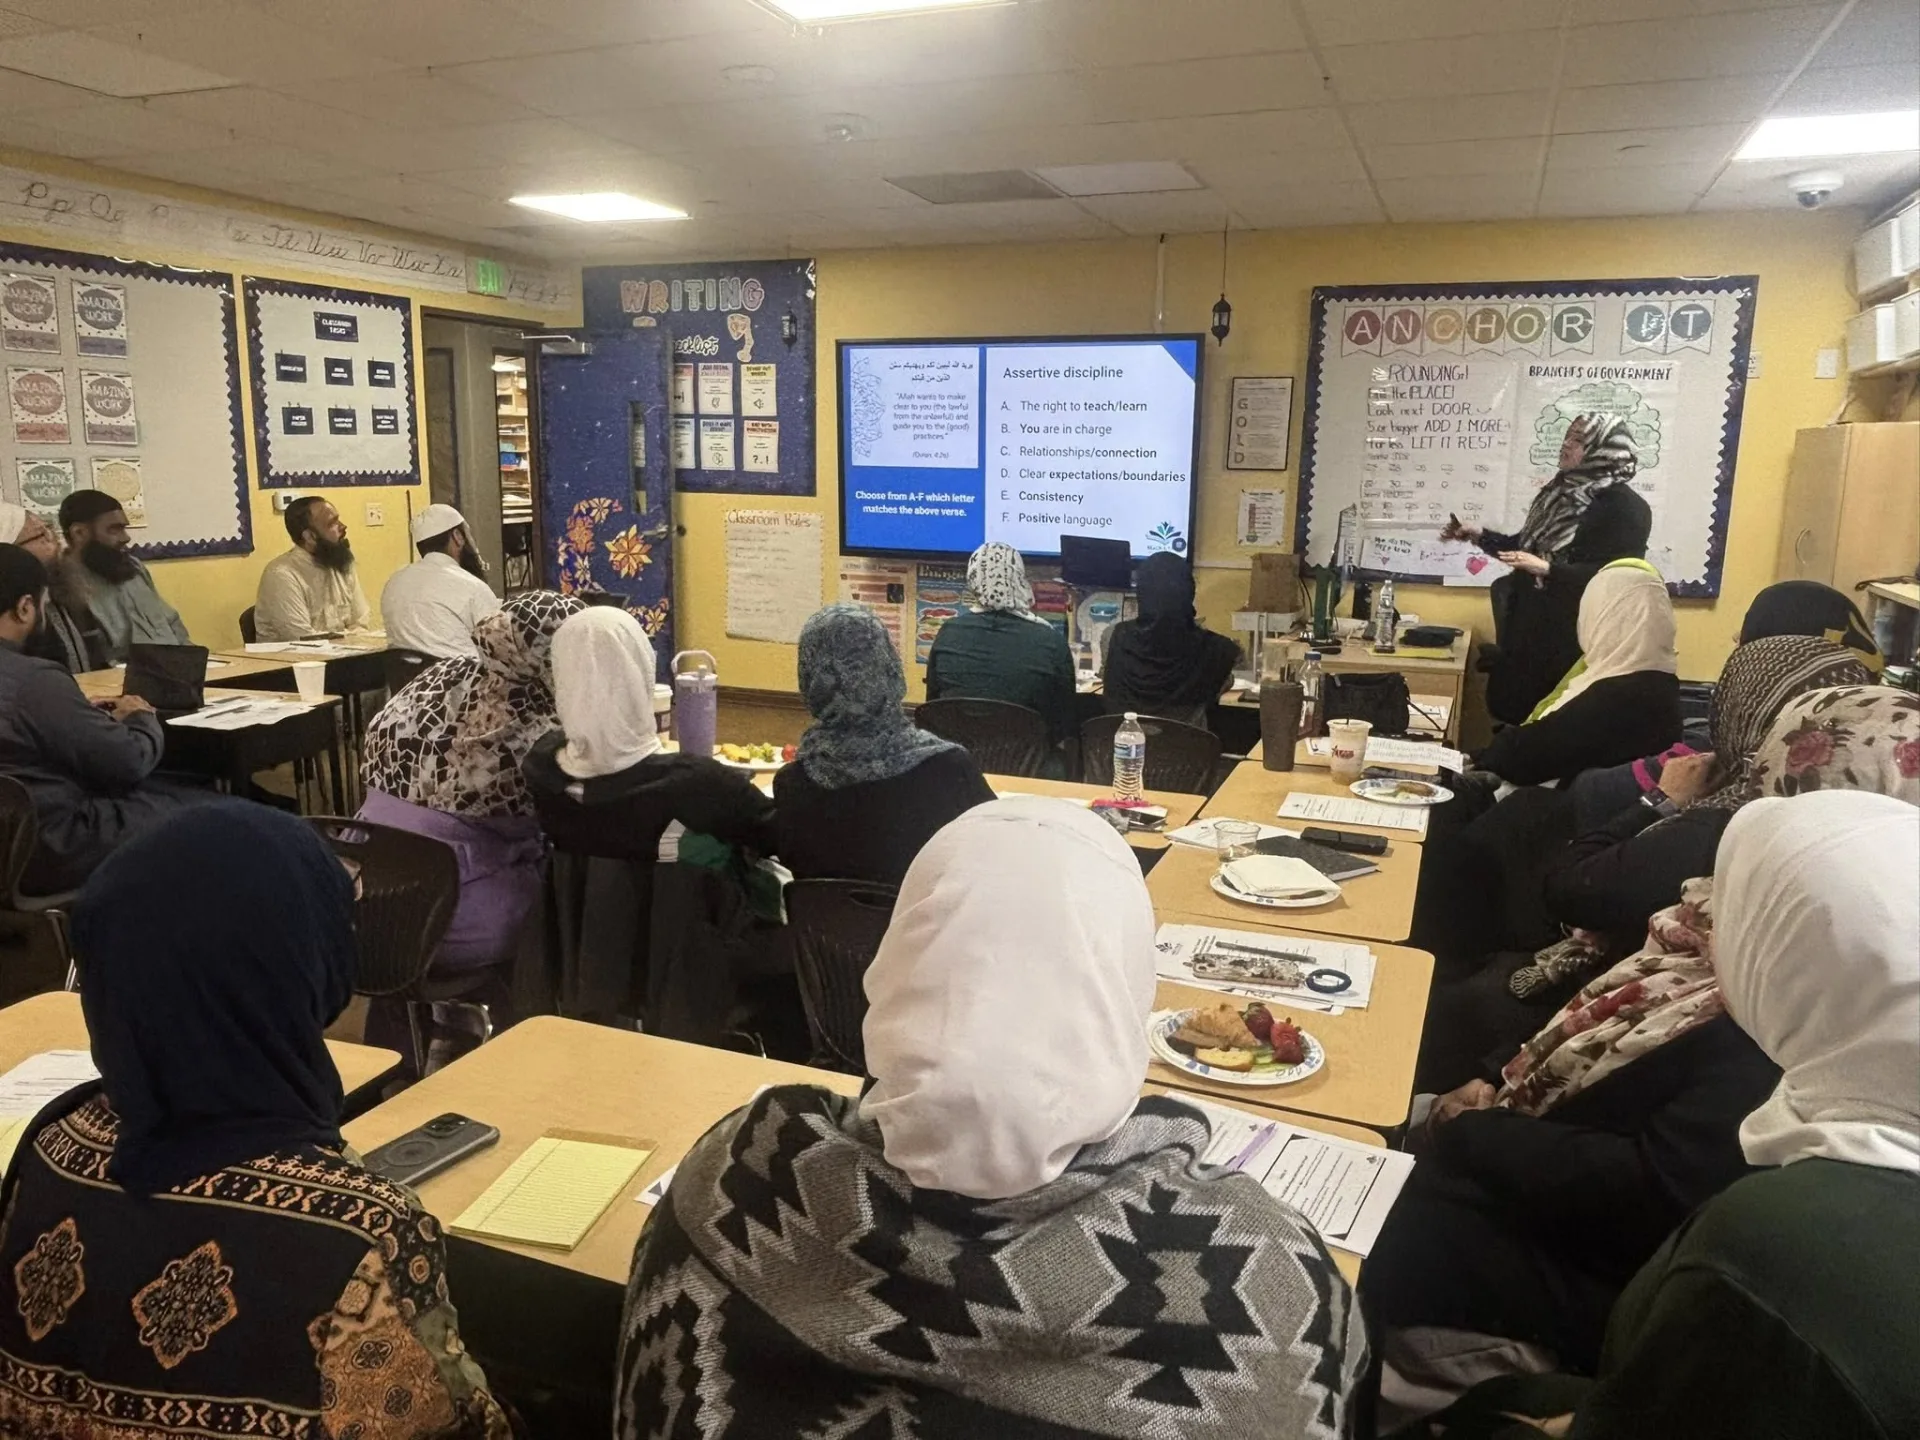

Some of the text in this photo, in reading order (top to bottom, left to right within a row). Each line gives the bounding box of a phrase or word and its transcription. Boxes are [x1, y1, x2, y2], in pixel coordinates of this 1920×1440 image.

[620, 277, 765, 313] WRITING
[1350, 306, 1588, 341] ANCHOR
[1003, 366, 1123, 381] Assertive discipline
[1388, 364, 1469, 383] ROUNDING!
[1528, 365, 1584, 379] BRANCHES
[1600, 365, 1673, 381] GOVERNMENT
[1409, 385, 1455, 400] PLACE!
[1001, 401, 1148, 414] A. The right to teach/learn
[1431, 402, 1471, 416] DOOR
[1001, 424, 1113, 437] B. You are in charge
[1424, 419, 1451, 433] ADD
[1411, 436, 1435, 449] LET
[1458, 436, 1494, 449] REST
[1000, 446, 1158, 459] C. Relationships/connection
[1000, 468, 1186, 482] D. Clear expectations/boundaries
[855, 490, 976, 503] Choose from A-F which letter
[1001, 490, 1084, 504] E. Consistency
[862, 504, 968, 517] matches the above verse.
[727, 508, 812, 528] Classroom Rules
[1002, 512, 1113, 528] F. Positive language
